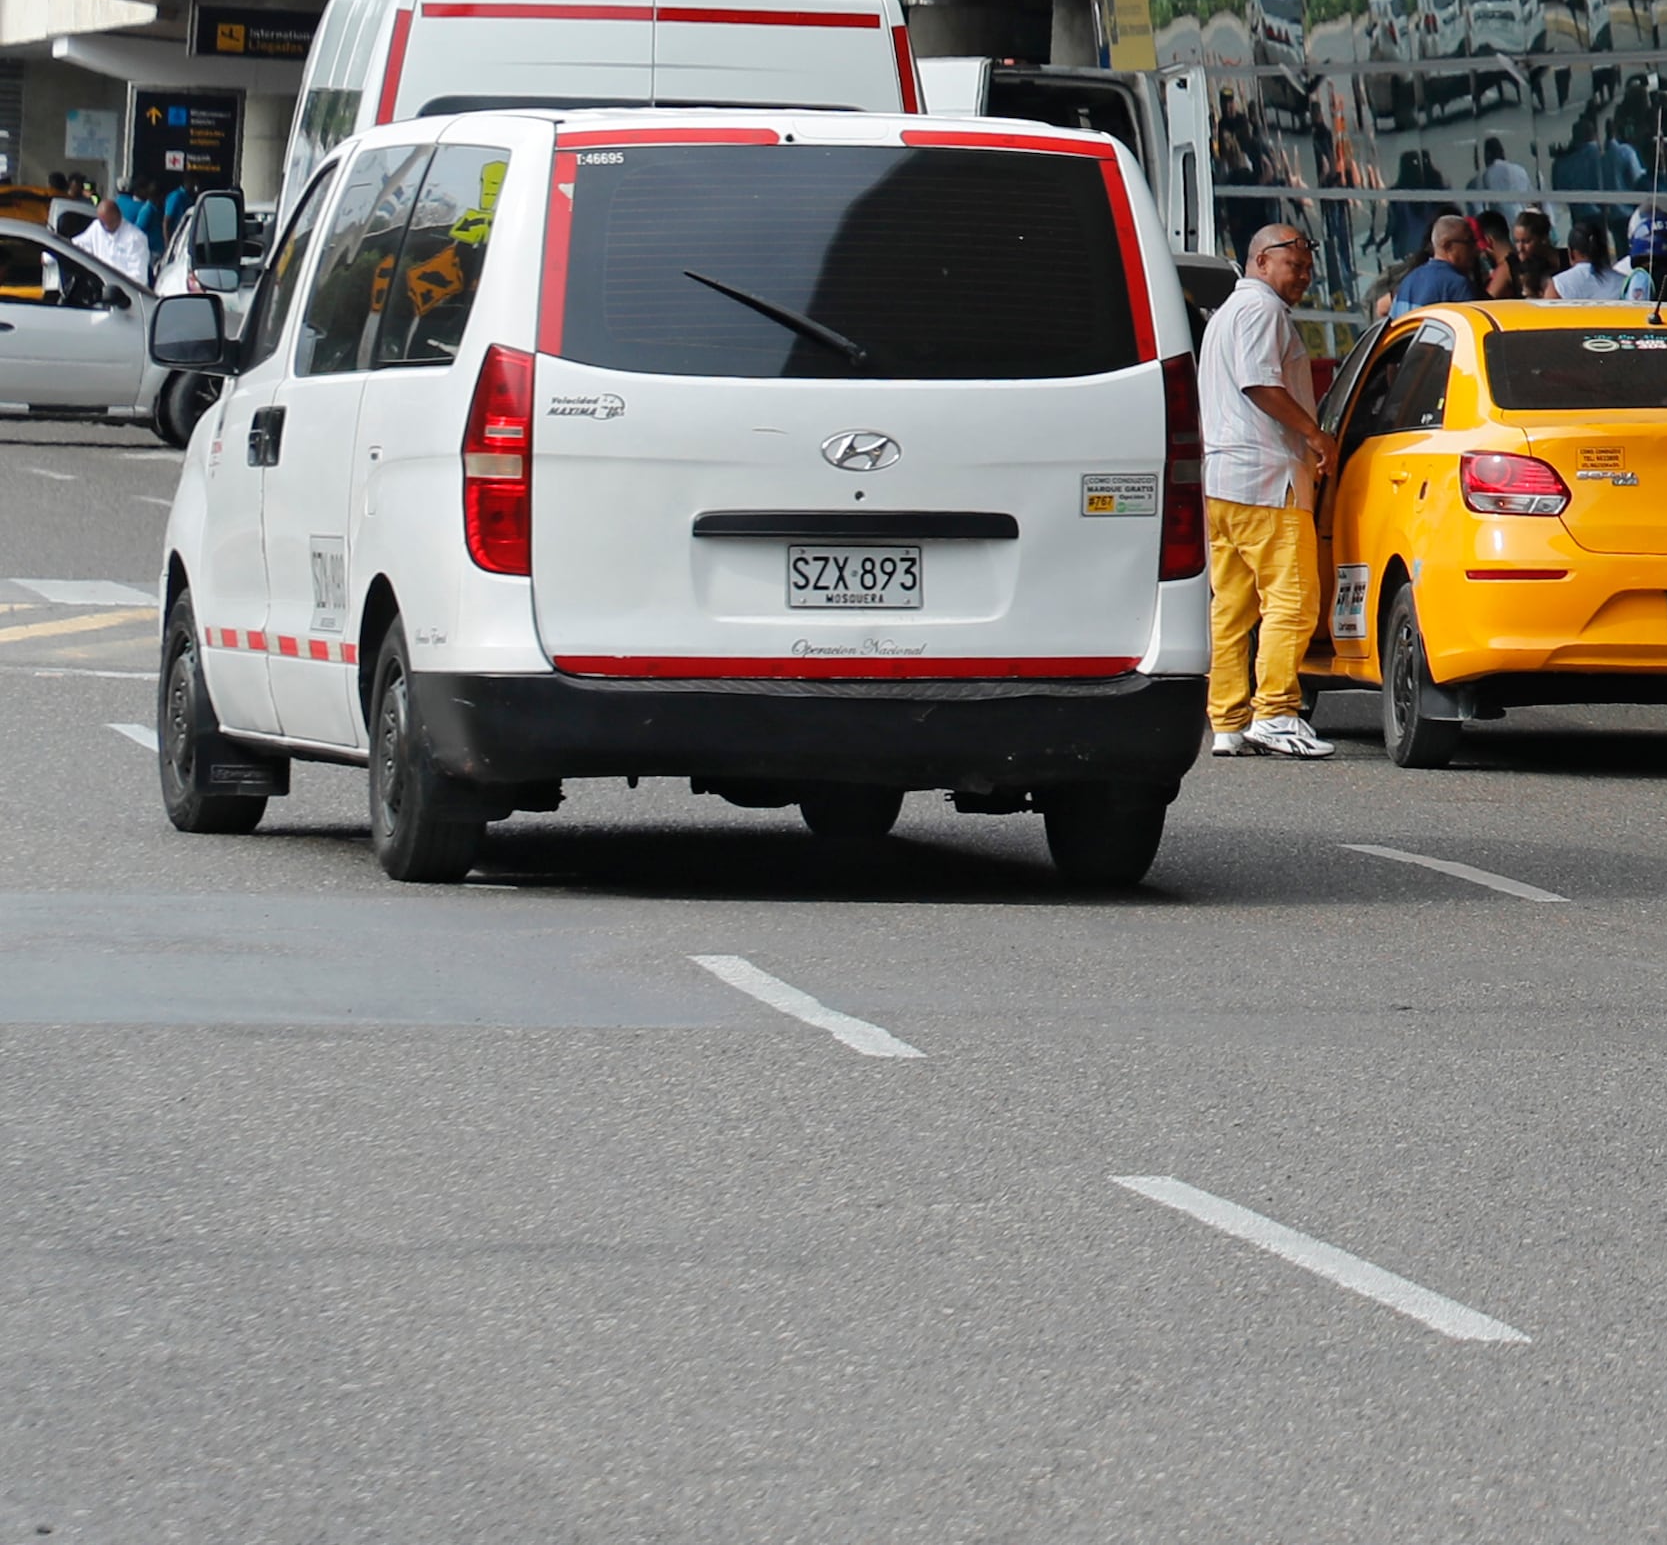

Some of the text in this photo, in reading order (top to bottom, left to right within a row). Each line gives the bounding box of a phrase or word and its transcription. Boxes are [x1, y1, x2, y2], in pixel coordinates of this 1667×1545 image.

[546, 406, 598, 415] MAXIMA
[792, 556, 918, 591] SZX 893
[825, 593, 884, 603] MOSQUERA
[791, 638, 927, 658] Operacion Nacional
